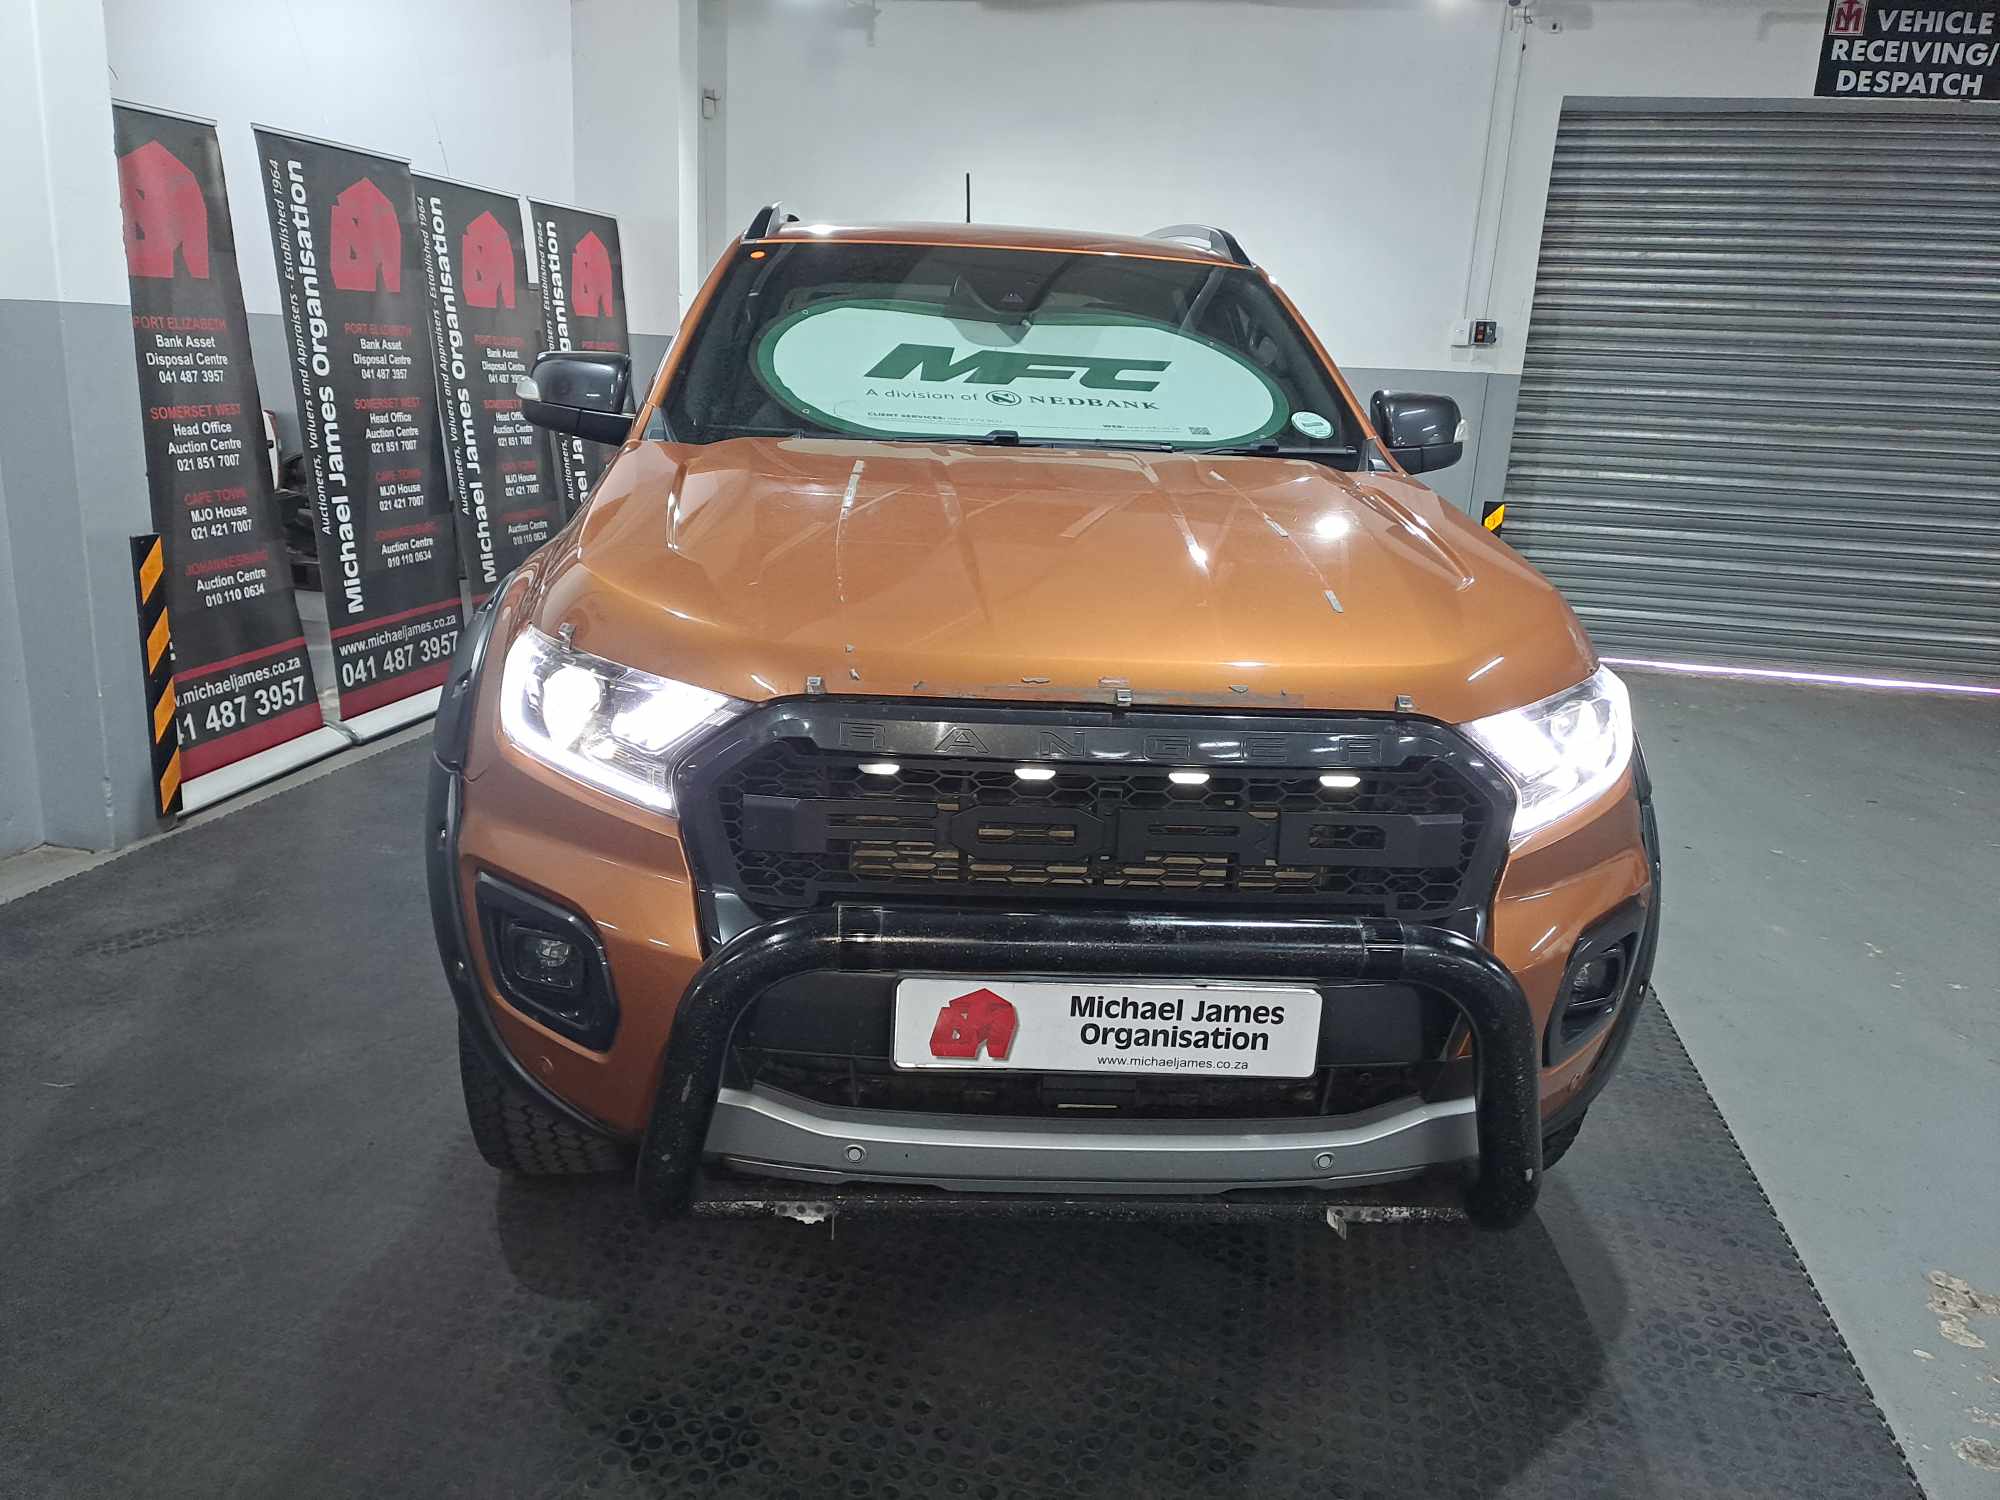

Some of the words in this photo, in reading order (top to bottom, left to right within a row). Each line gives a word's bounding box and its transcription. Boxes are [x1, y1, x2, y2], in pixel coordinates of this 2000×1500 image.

[1878, 9, 1996, 35] VEHICLE
[1831, 39, 2000, 66] RECEIVING/
[1836, 70, 1984, 96] DESPATCH
[269, 159, 282, 195] 1964
[416, 197, 428, 226] 1964
[274, 198, 295, 281] Established
[287, 160, 330, 377] Organisation
[420, 229, 438, 299] Established
[430, 197, 466, 380] Organisation
[155, 334, 183, 348] Bank
[185, 335, 216, 348] Asset
[290, 293, 309, 367] Appraisers
[433, 309, 449, 371] Appraisers
[360, 338, 380, 350] Bank
[382, 339, 402, 350] Asset
[146, 353, 194, 368] Disposal
[196, 353, 228, 365] Centre
[353, 354, 387, 367] Disposal
[389, 354, 412, 365] Centre
[361, 369, 375, 379] 041
[863, 343, 1172, 392] MFC
[159, 371, 177, 383] 041
[180, 370, 198, 383] 487
[201, 370, 224, 382] 3957
[299, 368, 311, 396] and
[441, 373, 452, 396] and
[865, 387, 879, 397] A
[884, 389, 955, 401] division
[960, 392, 978, 401] of
[1029, 395, 1160, 410] NEDBANK
[173, 423, 200, 437] Head
[202, 421, 232, 434] Office
[305, 399, 318, 449] Valuers
[370, 413, 389, 424] Head
[391, 411, 412, 423] Office
[447, 399, 458, 441] Valuers
[457, 388, 481, 474] James
[319, 386, 348, 487] James
[365, 428, 394, 439] Auction
[396, 425, 419, 437] Centre
[168, 441, 208, 455] Auction
[210, 438, 242, 451] Centre
[371, 443, 384, 453] 021
[177, 458, 195, 471] 021
[197, 456, 215, 470] 851
[218, 454, 240, 467] 7007
[313, 454, 332, 535] Auctioneers,
[380, 485, 396, 496] MJO
[398, 483, 421, 494] House
[454, 447, 470, 515] Auctioneers,
[191, 508, 213, 523] MJO
[215, 505, 248, 519] House
[191, 525, 208, 540] 021
[211, 522, 229, 537] 421
[231, 519, 253, 533] 7007
[469, 482, 497, 583] Michael
[331, 496, 364, 614] Michael
[382, 542, 409, 555] Auction
[411, 537, 434, 549] Centre
[196, 575, 235, 592] Auction
[237, 568, 267, 583] Centre
[205, 593, 223, 607] 010
[224, 588, 242, 603] 110
[244, 583, 265, 598] 0634
[339, 615, 456, 656] www.michaeljames.co.za
[342, 656, 376, 687] 041
[383, 644, 414, 672] 487
[420, 631, 458, 662] 3957
[206, 696, 247, 731] 487
[254, 676, 305, 715] 3957
[839, 721, 1382, 763] RANGER
[1069, 995, 1184, 1021] Michael
[1191, 999, 1285, 1025] James
[1080, 1023, 1269, 1051] Organisation
[1097, 1056, 1249, 1070] www.michaeljames.co.za
